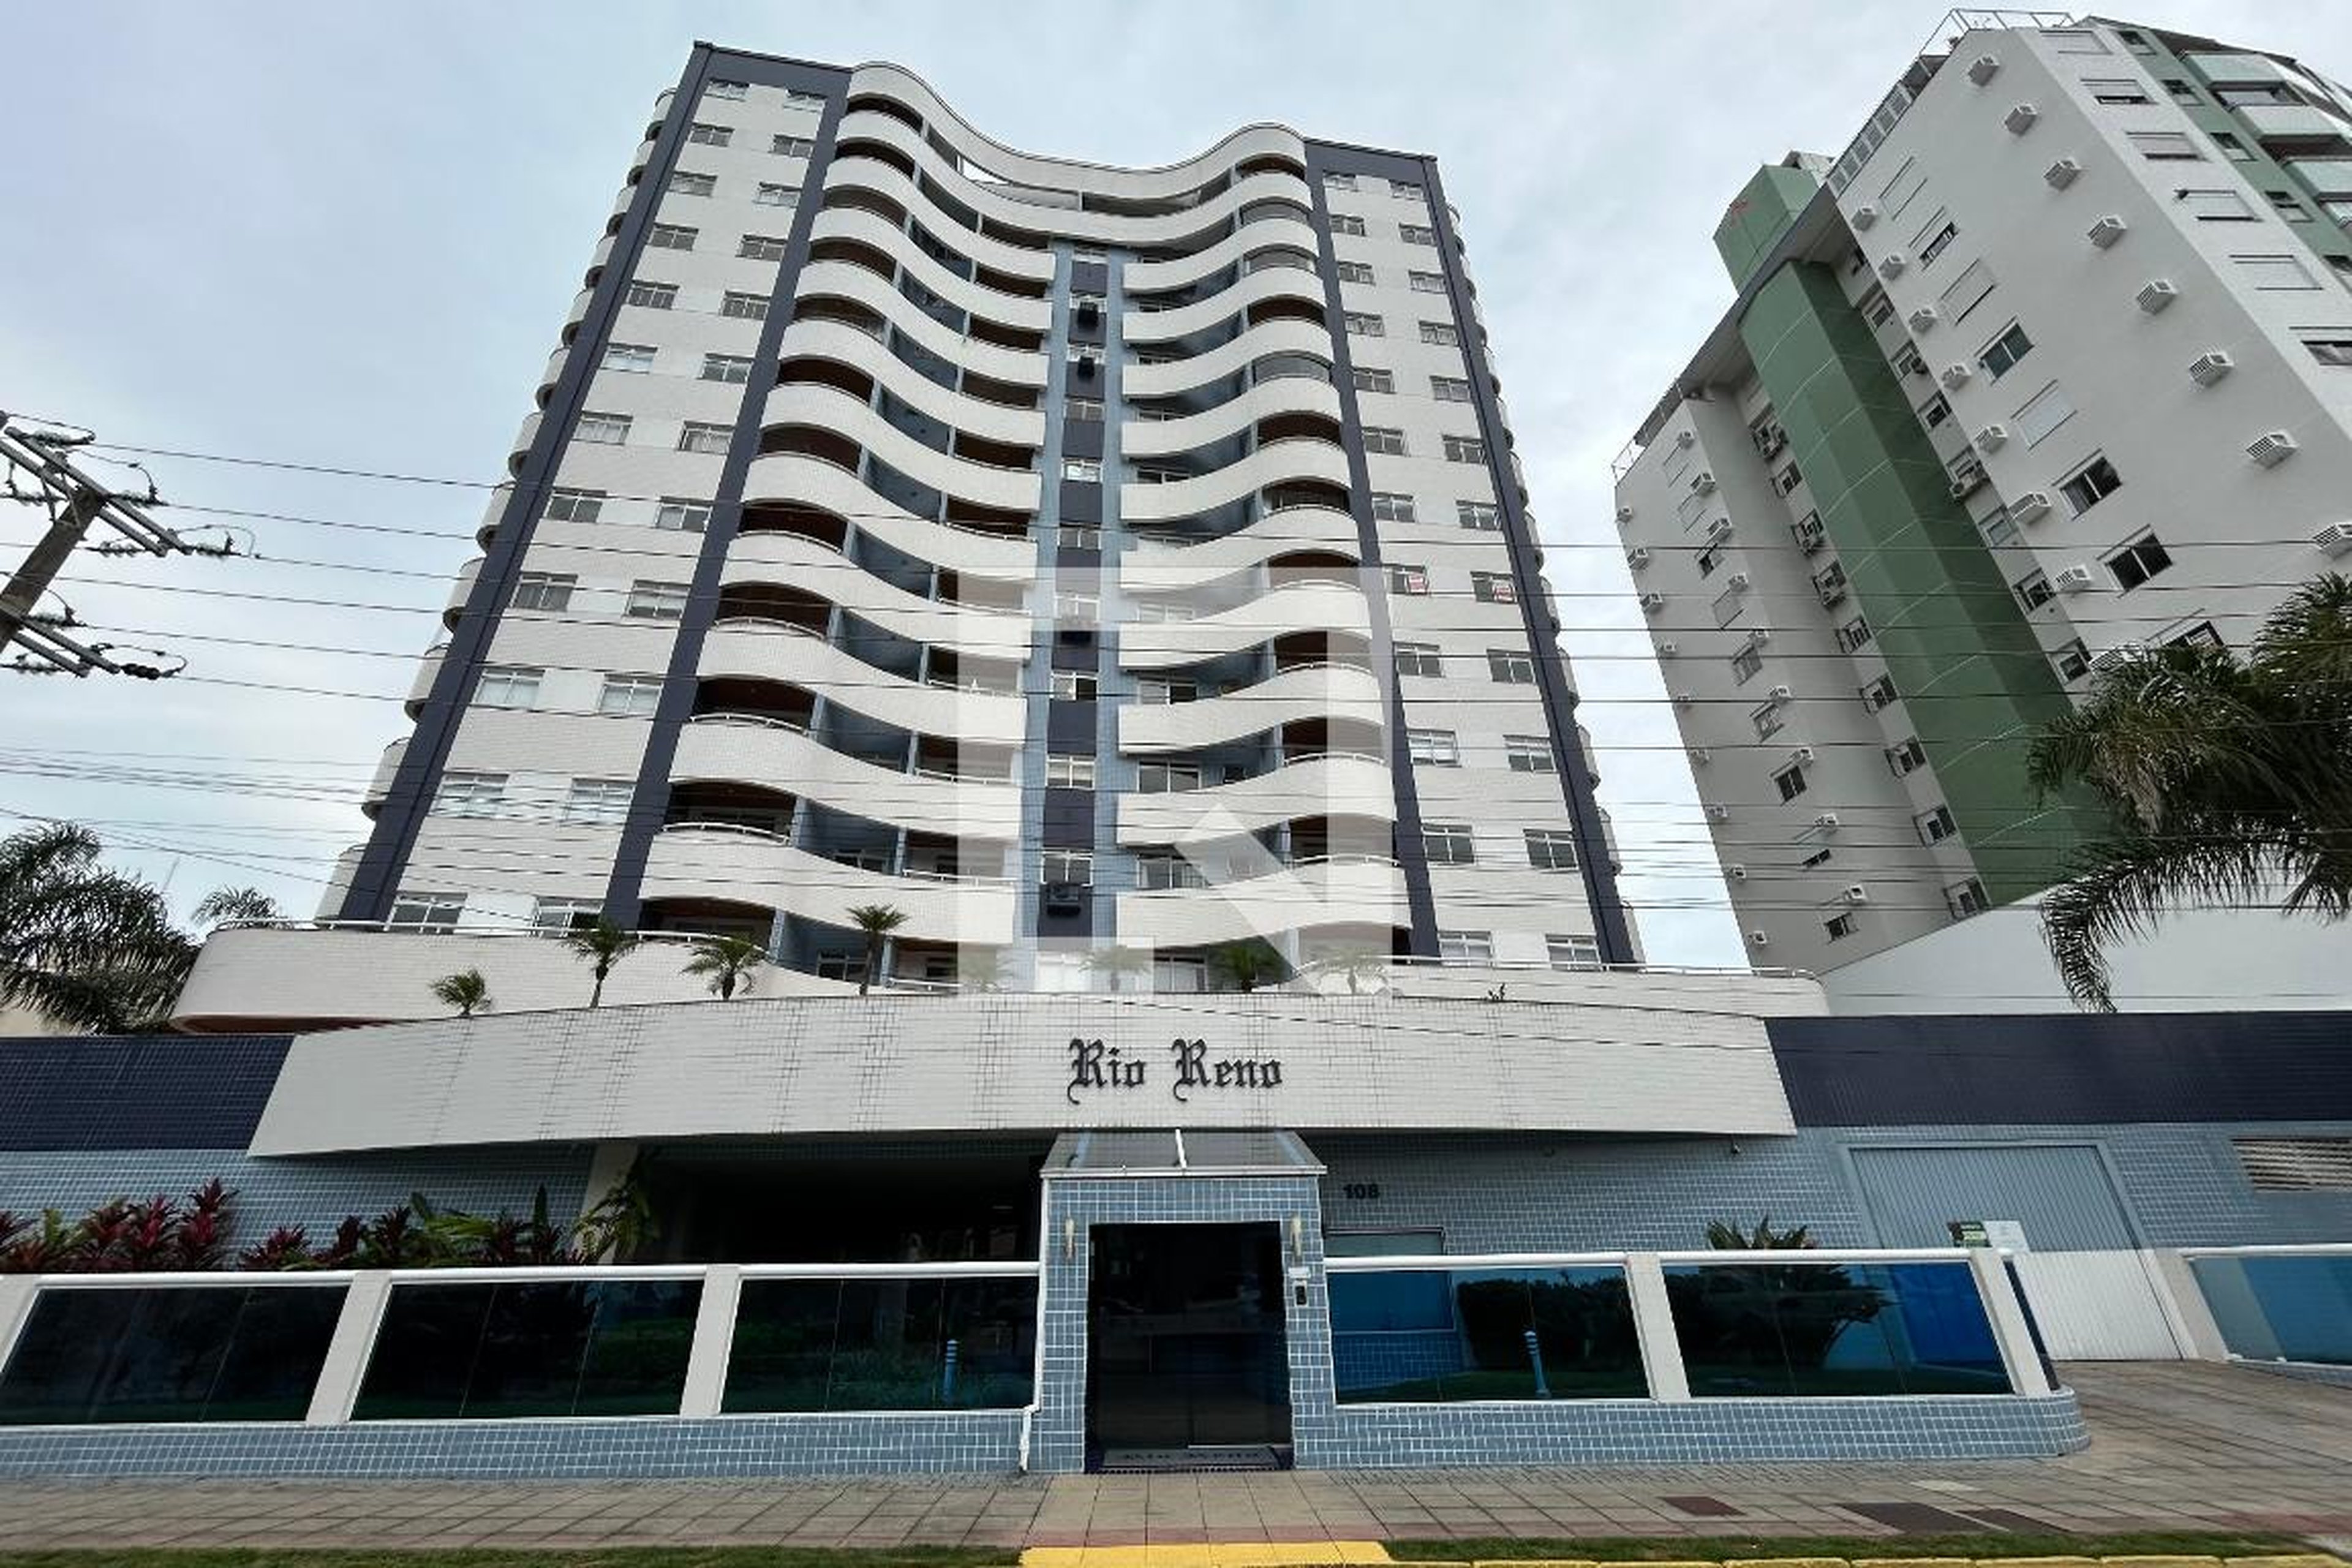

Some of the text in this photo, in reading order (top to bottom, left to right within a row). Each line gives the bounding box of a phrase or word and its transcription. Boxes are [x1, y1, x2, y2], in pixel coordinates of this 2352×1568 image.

[1068, 1038, 1283, 1104] Rio Reno
[1343, 1183, 1380, 1199] 108
